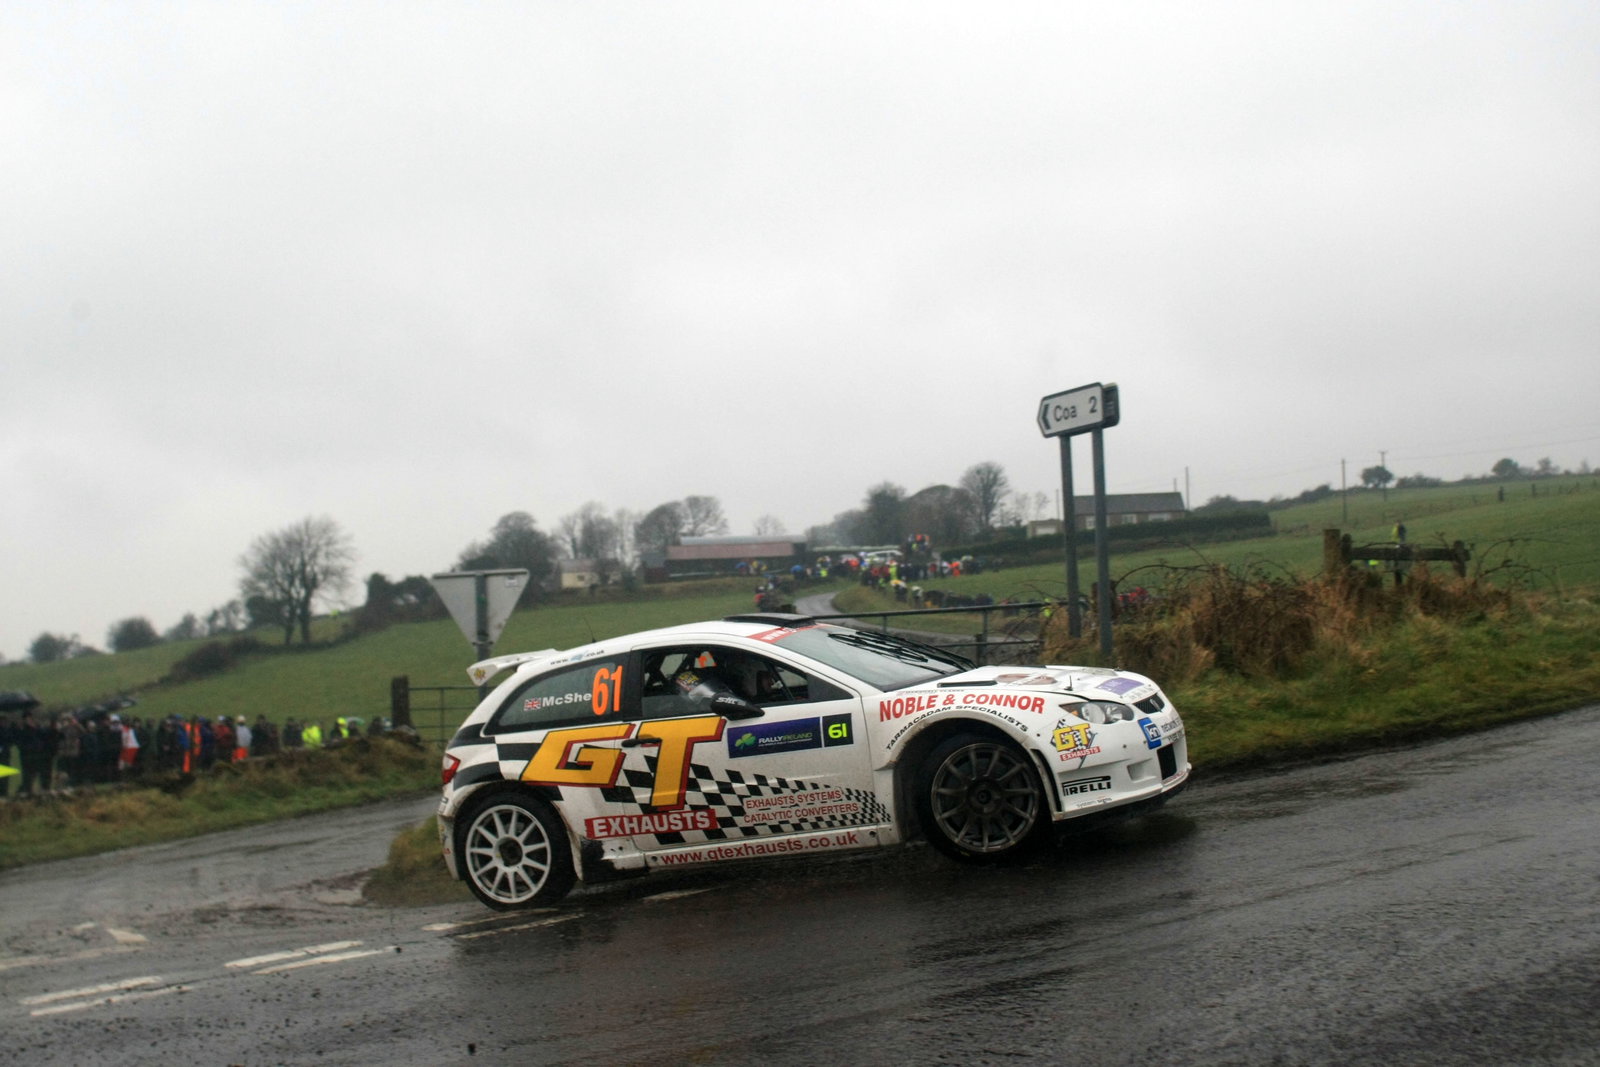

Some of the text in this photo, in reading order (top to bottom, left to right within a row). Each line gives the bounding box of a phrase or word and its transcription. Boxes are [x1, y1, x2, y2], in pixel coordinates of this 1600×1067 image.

[1053, 395, 1098, 422] Coa 2
[591, 665, 623, 716] 61
[879, 693, 1045, 722] NOBLE & CONNOR
[828, 723, 848, 739] 61
[886, 705, 1029, 751] TARMACADAM SPECIALISTS
[1052, 723, 1091, 752] GT
[519, 716, 727, 811] GT
[1061, 747, 1100, 761] EXHAUSTS
[1061, 775, 1112, 796] PIRELLI
[744, 802, 859, 823] CATALYTIC CONVERTERS
[746, 790, 842, 809] EXHAUSTS SYSTEMS
[592, 811, 711, 838] EXHAUSTS
[661, 831, 859, 865] www.gtexhausts.co.uk
